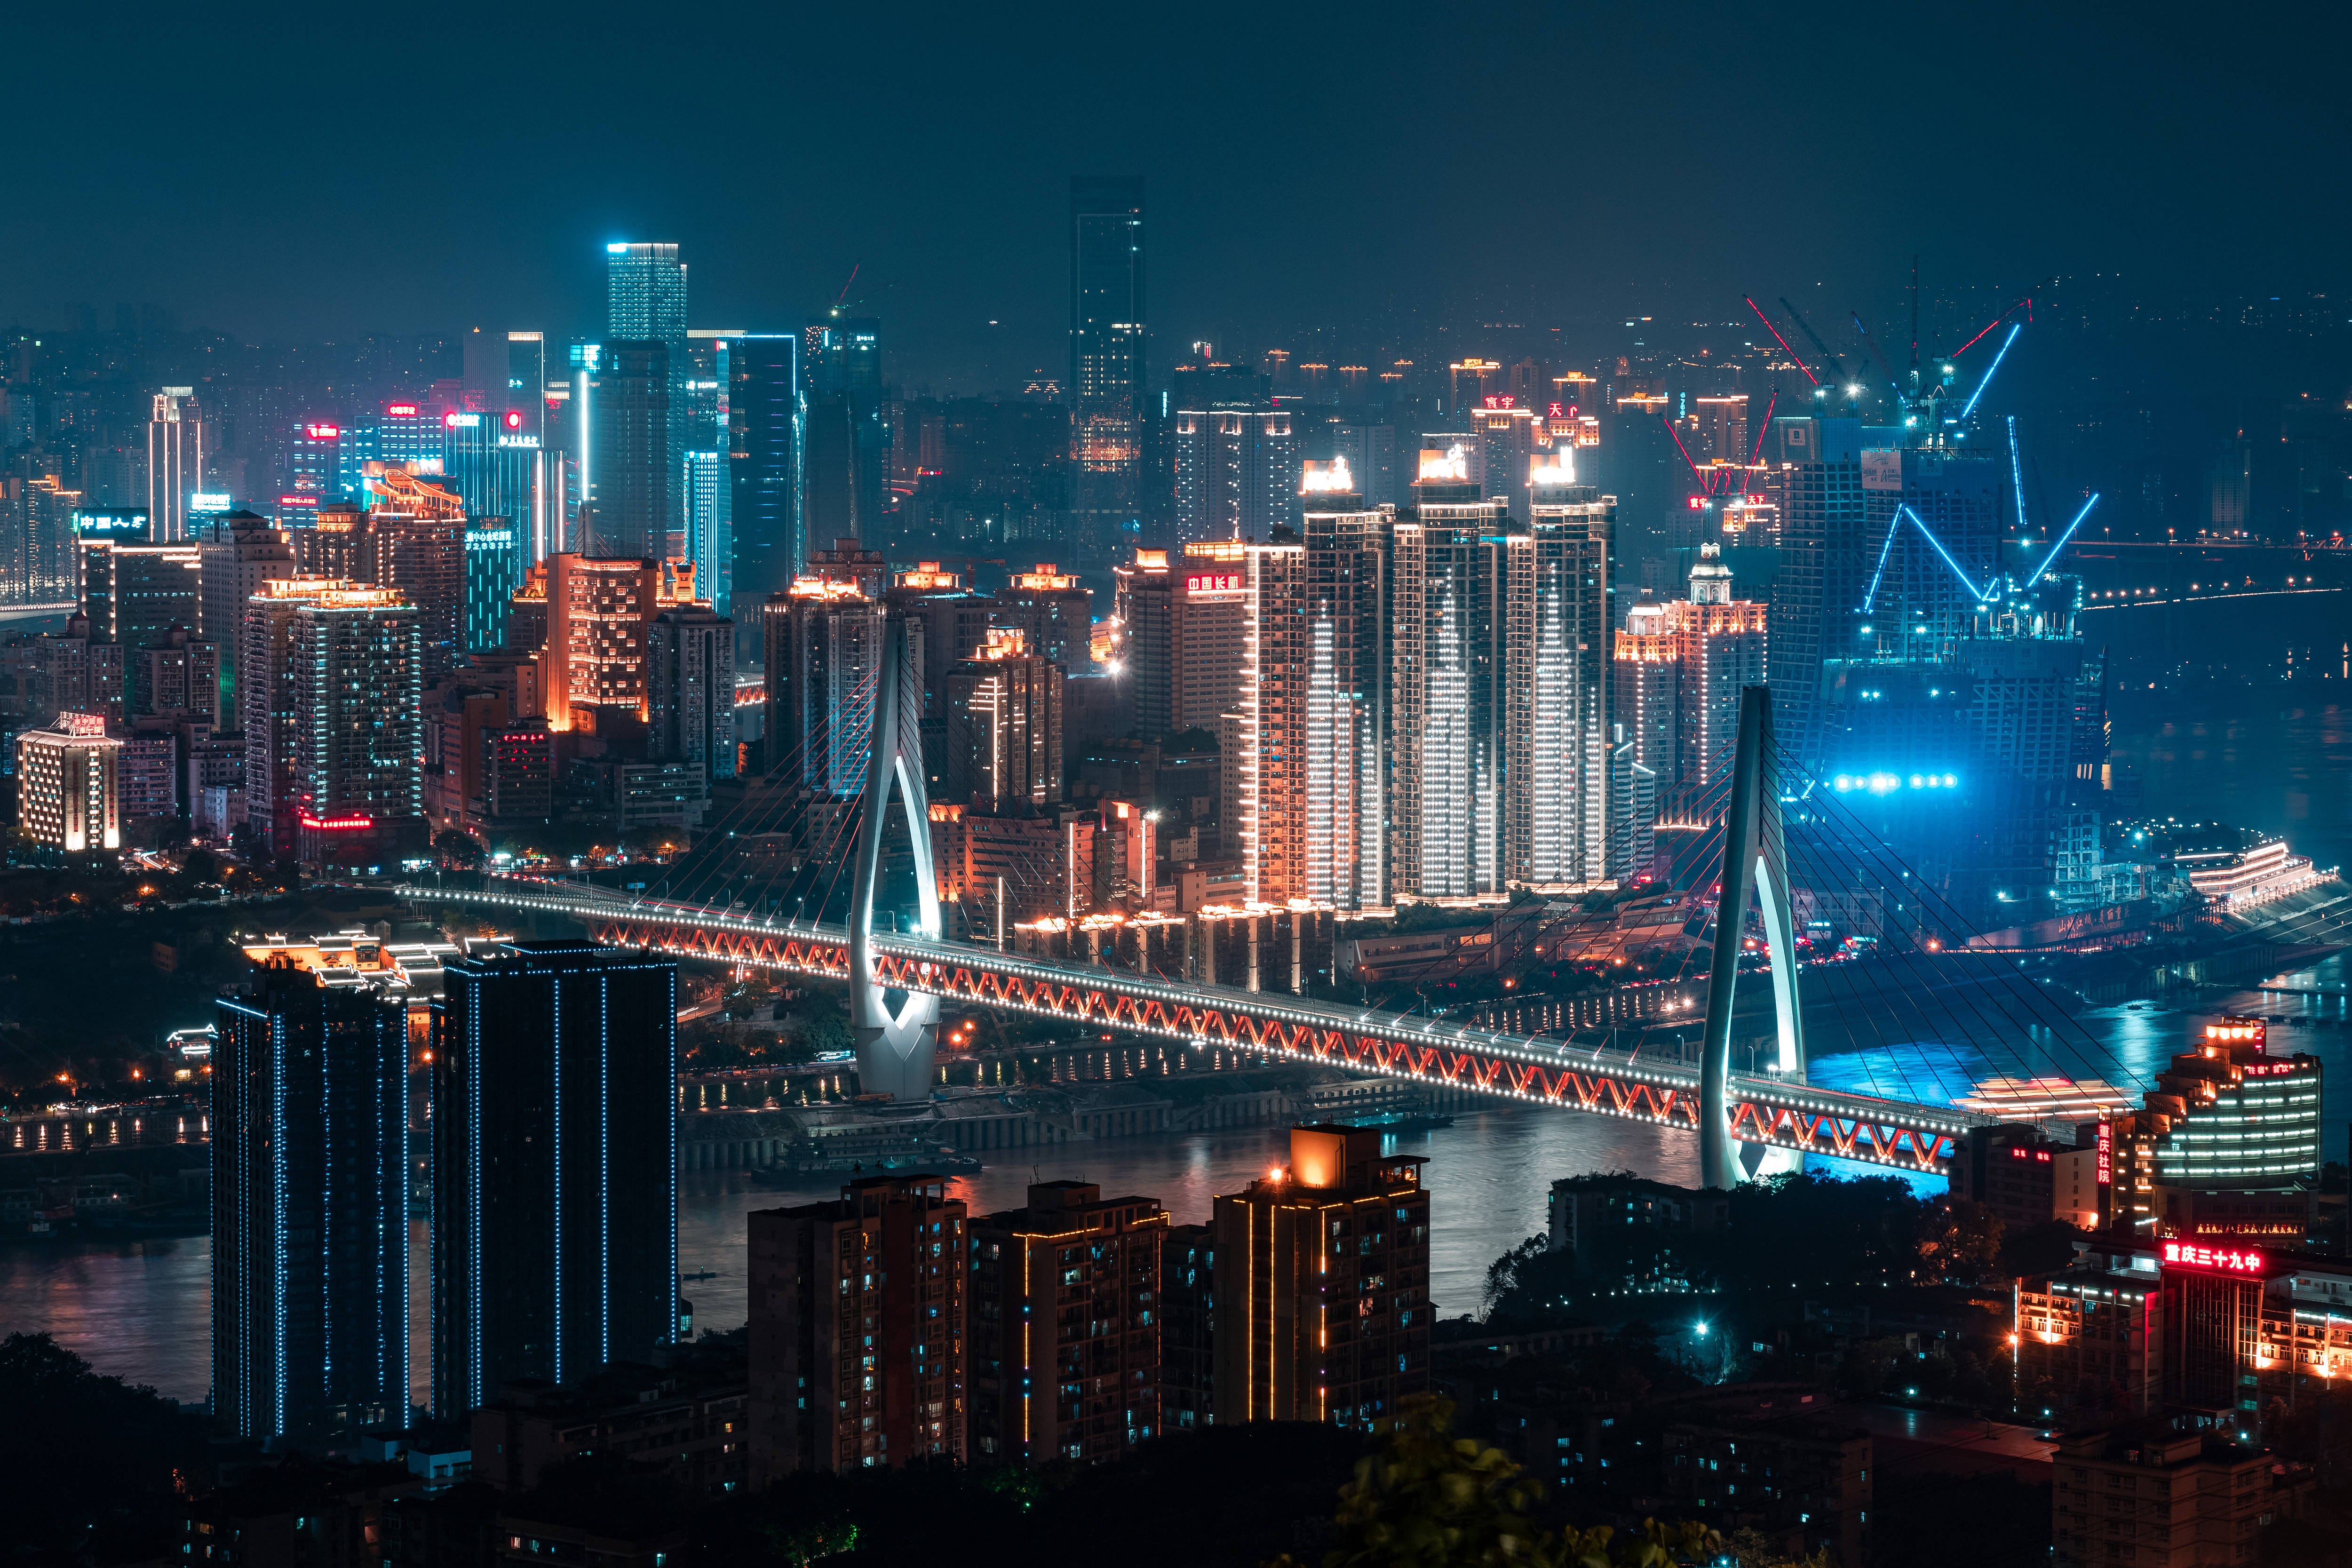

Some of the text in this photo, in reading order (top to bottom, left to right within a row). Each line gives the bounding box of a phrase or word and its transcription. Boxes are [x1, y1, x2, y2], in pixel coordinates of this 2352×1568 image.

[1748, 495, 1764, 504] 天下
[1189, 575, 1239, 590] 中国长航
[2098, 1124, 2109, 1183] 重庆社院
[2165, 1244, 2259, 1271] 重庆三十九中
